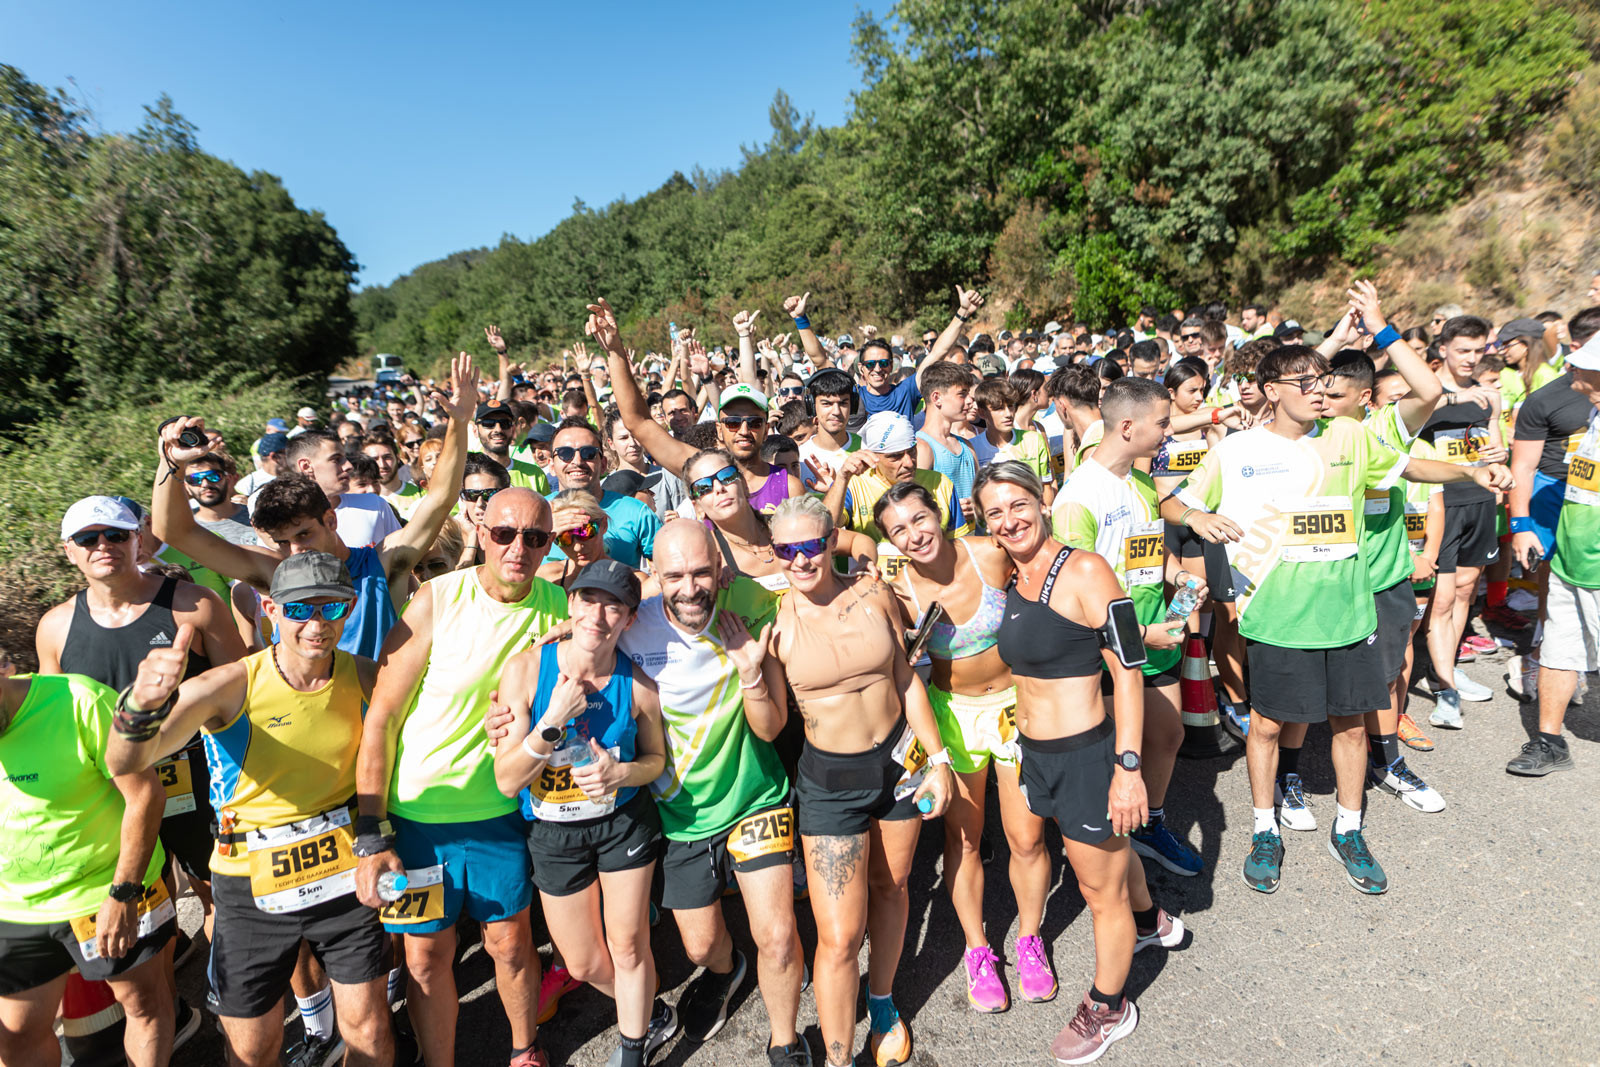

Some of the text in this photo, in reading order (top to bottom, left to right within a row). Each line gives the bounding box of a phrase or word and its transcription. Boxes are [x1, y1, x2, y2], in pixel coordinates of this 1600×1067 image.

[1293, 513, 1347, 535] 5903
[1050, 549, 1070, 576] PRO
[741, 813, 790, 846] 5215
[271, 835, 340, 878] 5193
[298, 885, 323, 897] 5 km
